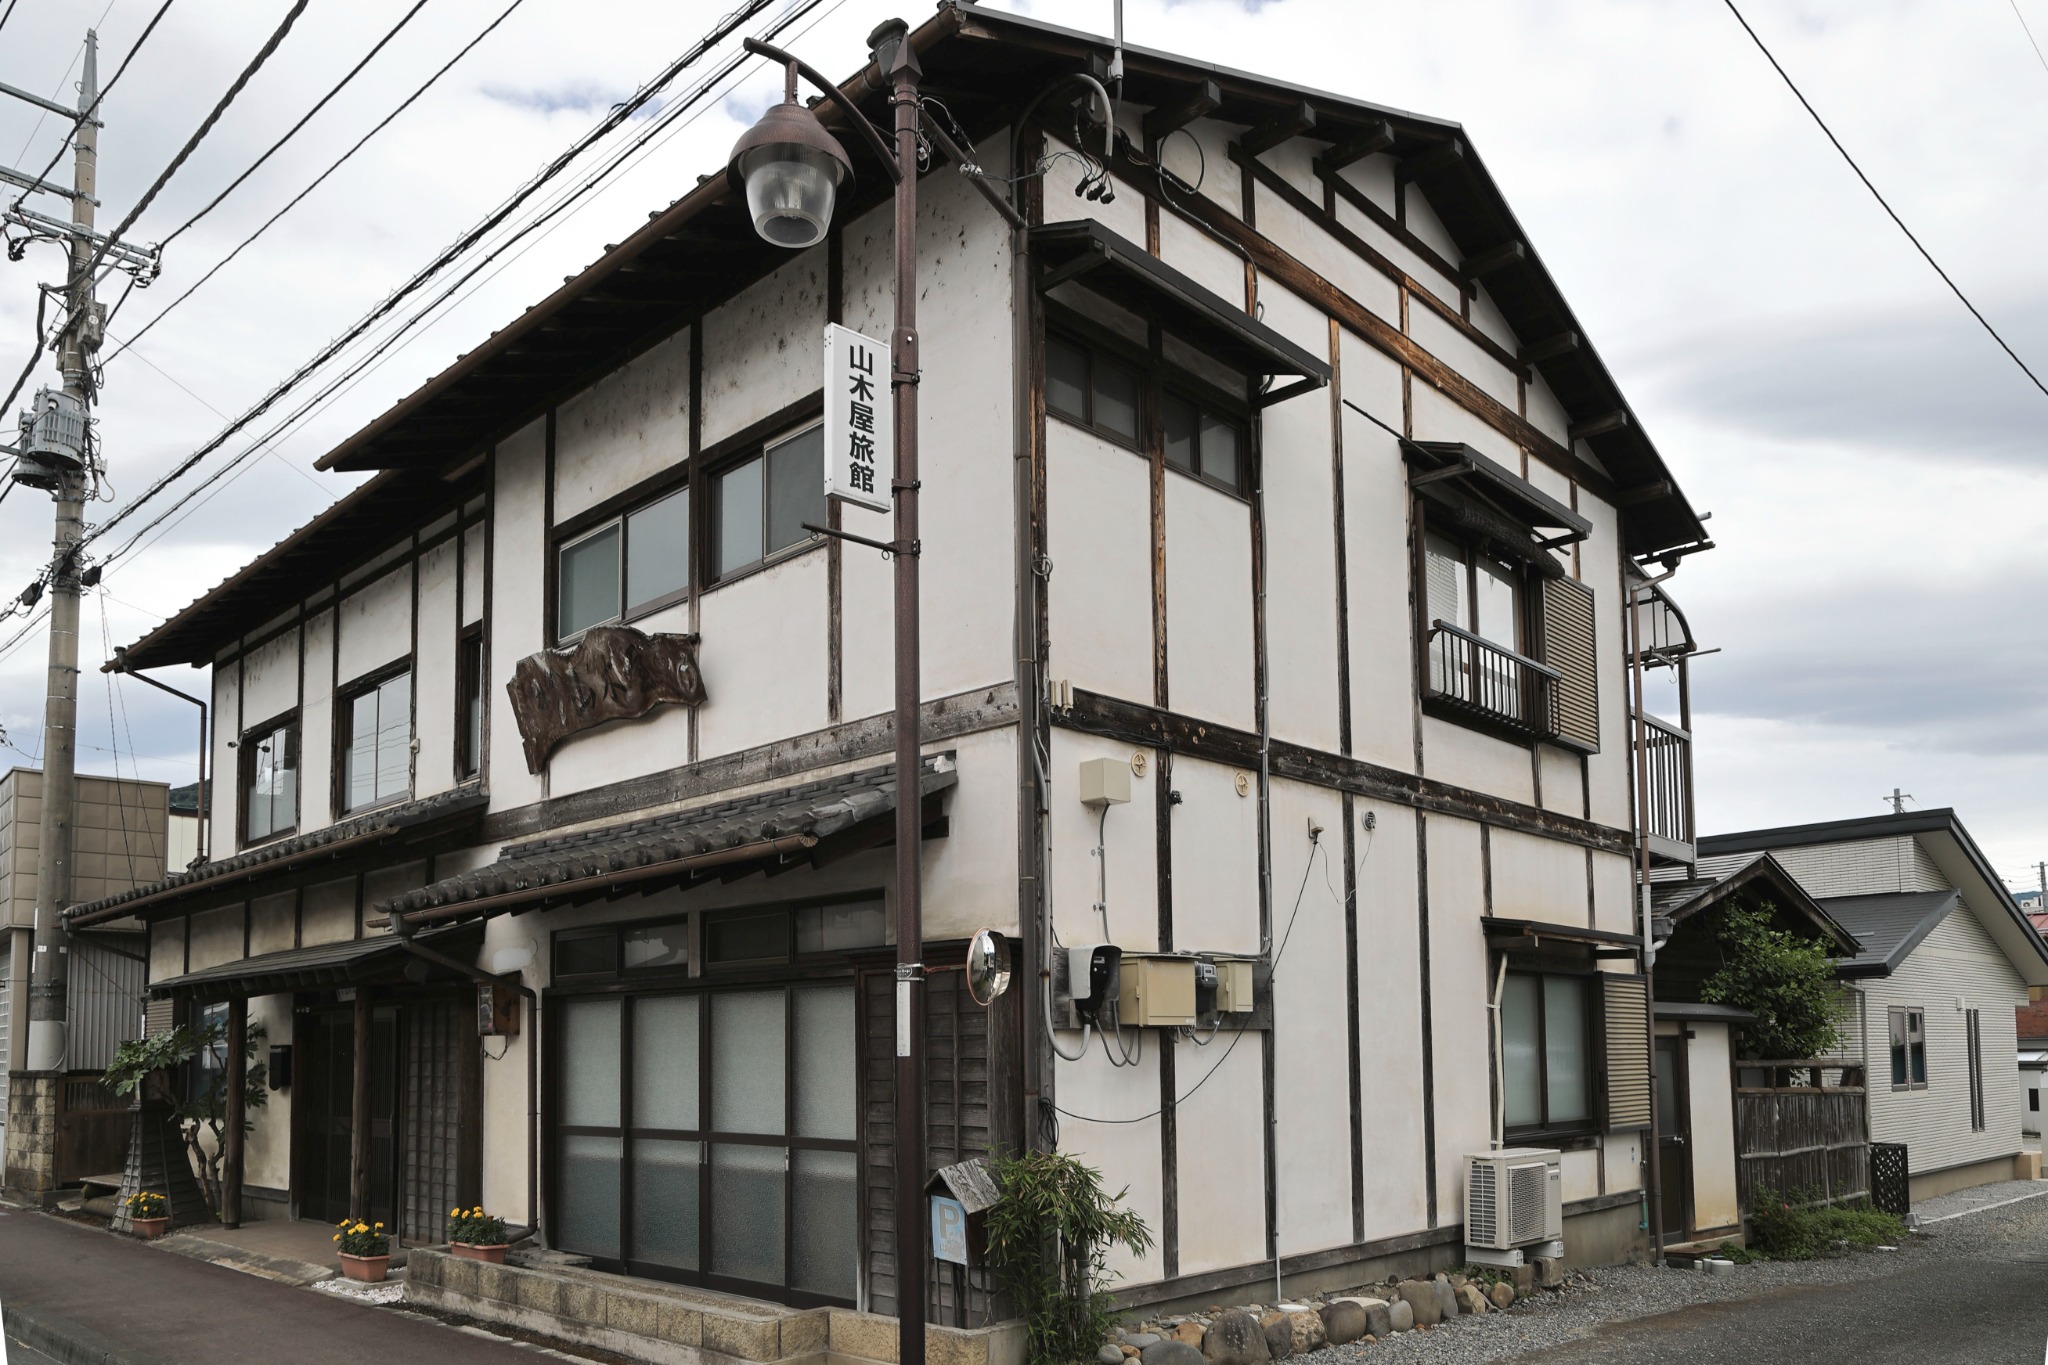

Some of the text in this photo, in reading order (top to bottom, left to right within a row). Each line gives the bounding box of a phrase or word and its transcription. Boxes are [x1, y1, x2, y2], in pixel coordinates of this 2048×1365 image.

[848, 344, 875, 495] 山木屋旅館
[939, 1203, 960, 1240] P
